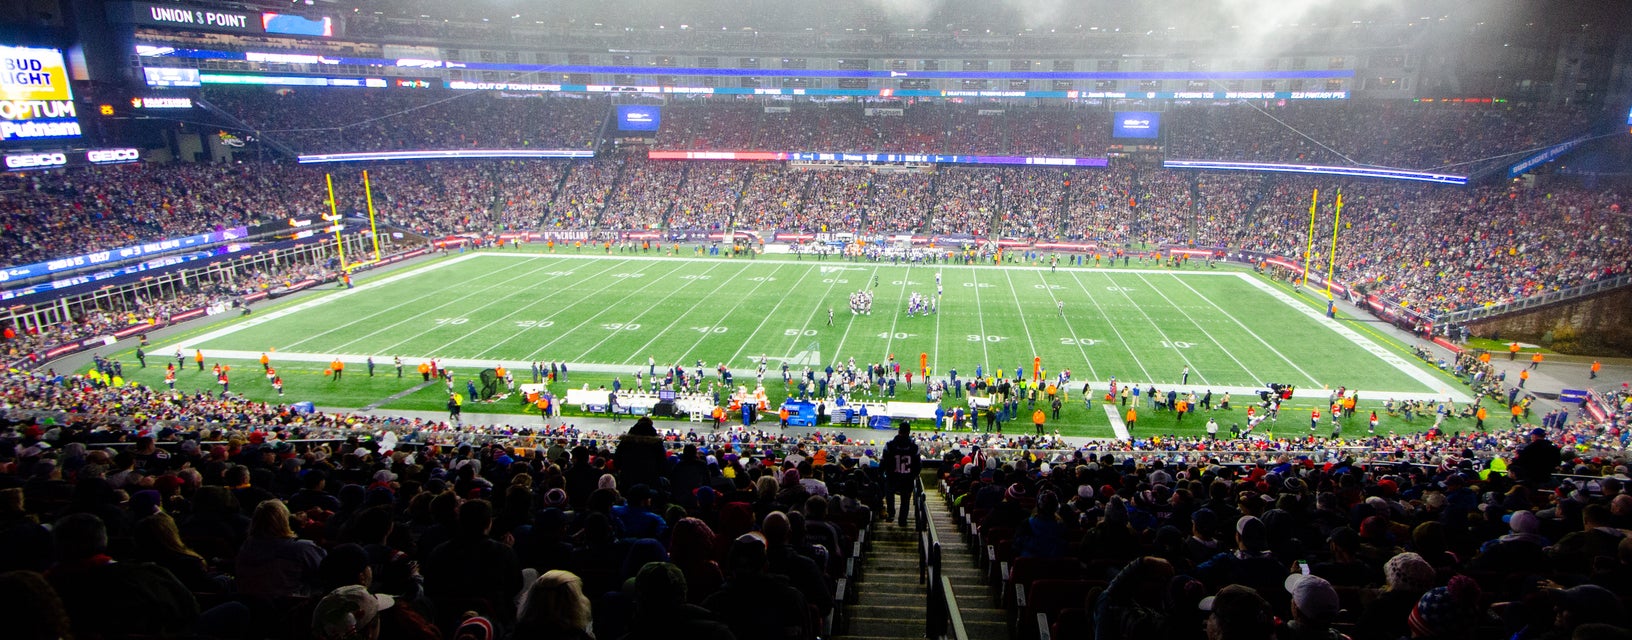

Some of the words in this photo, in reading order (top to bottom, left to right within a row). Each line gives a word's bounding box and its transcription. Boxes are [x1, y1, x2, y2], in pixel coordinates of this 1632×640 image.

[151, 7, 193, 23] UNION
[205, 12, 247, 28] POINT
[6, 59, 42, 71] BUD
[1, 73, 51, 85] LIGHT
[0, 101, 76, 119] OPTUM
[1, 121, 81, 138] Putnam
[6, 153, 67, 168] GEICO
[88, 149, 140, 162] GEICO
[784, 329, 818, 337] 50
[877, 332, 908, 340] 40
[967, 335, 1000, 343] 30
[1060, 338, 1095, 346] 20
[1159, 341, 1188, 349] 10
[894, 454, 911, 474] 12
